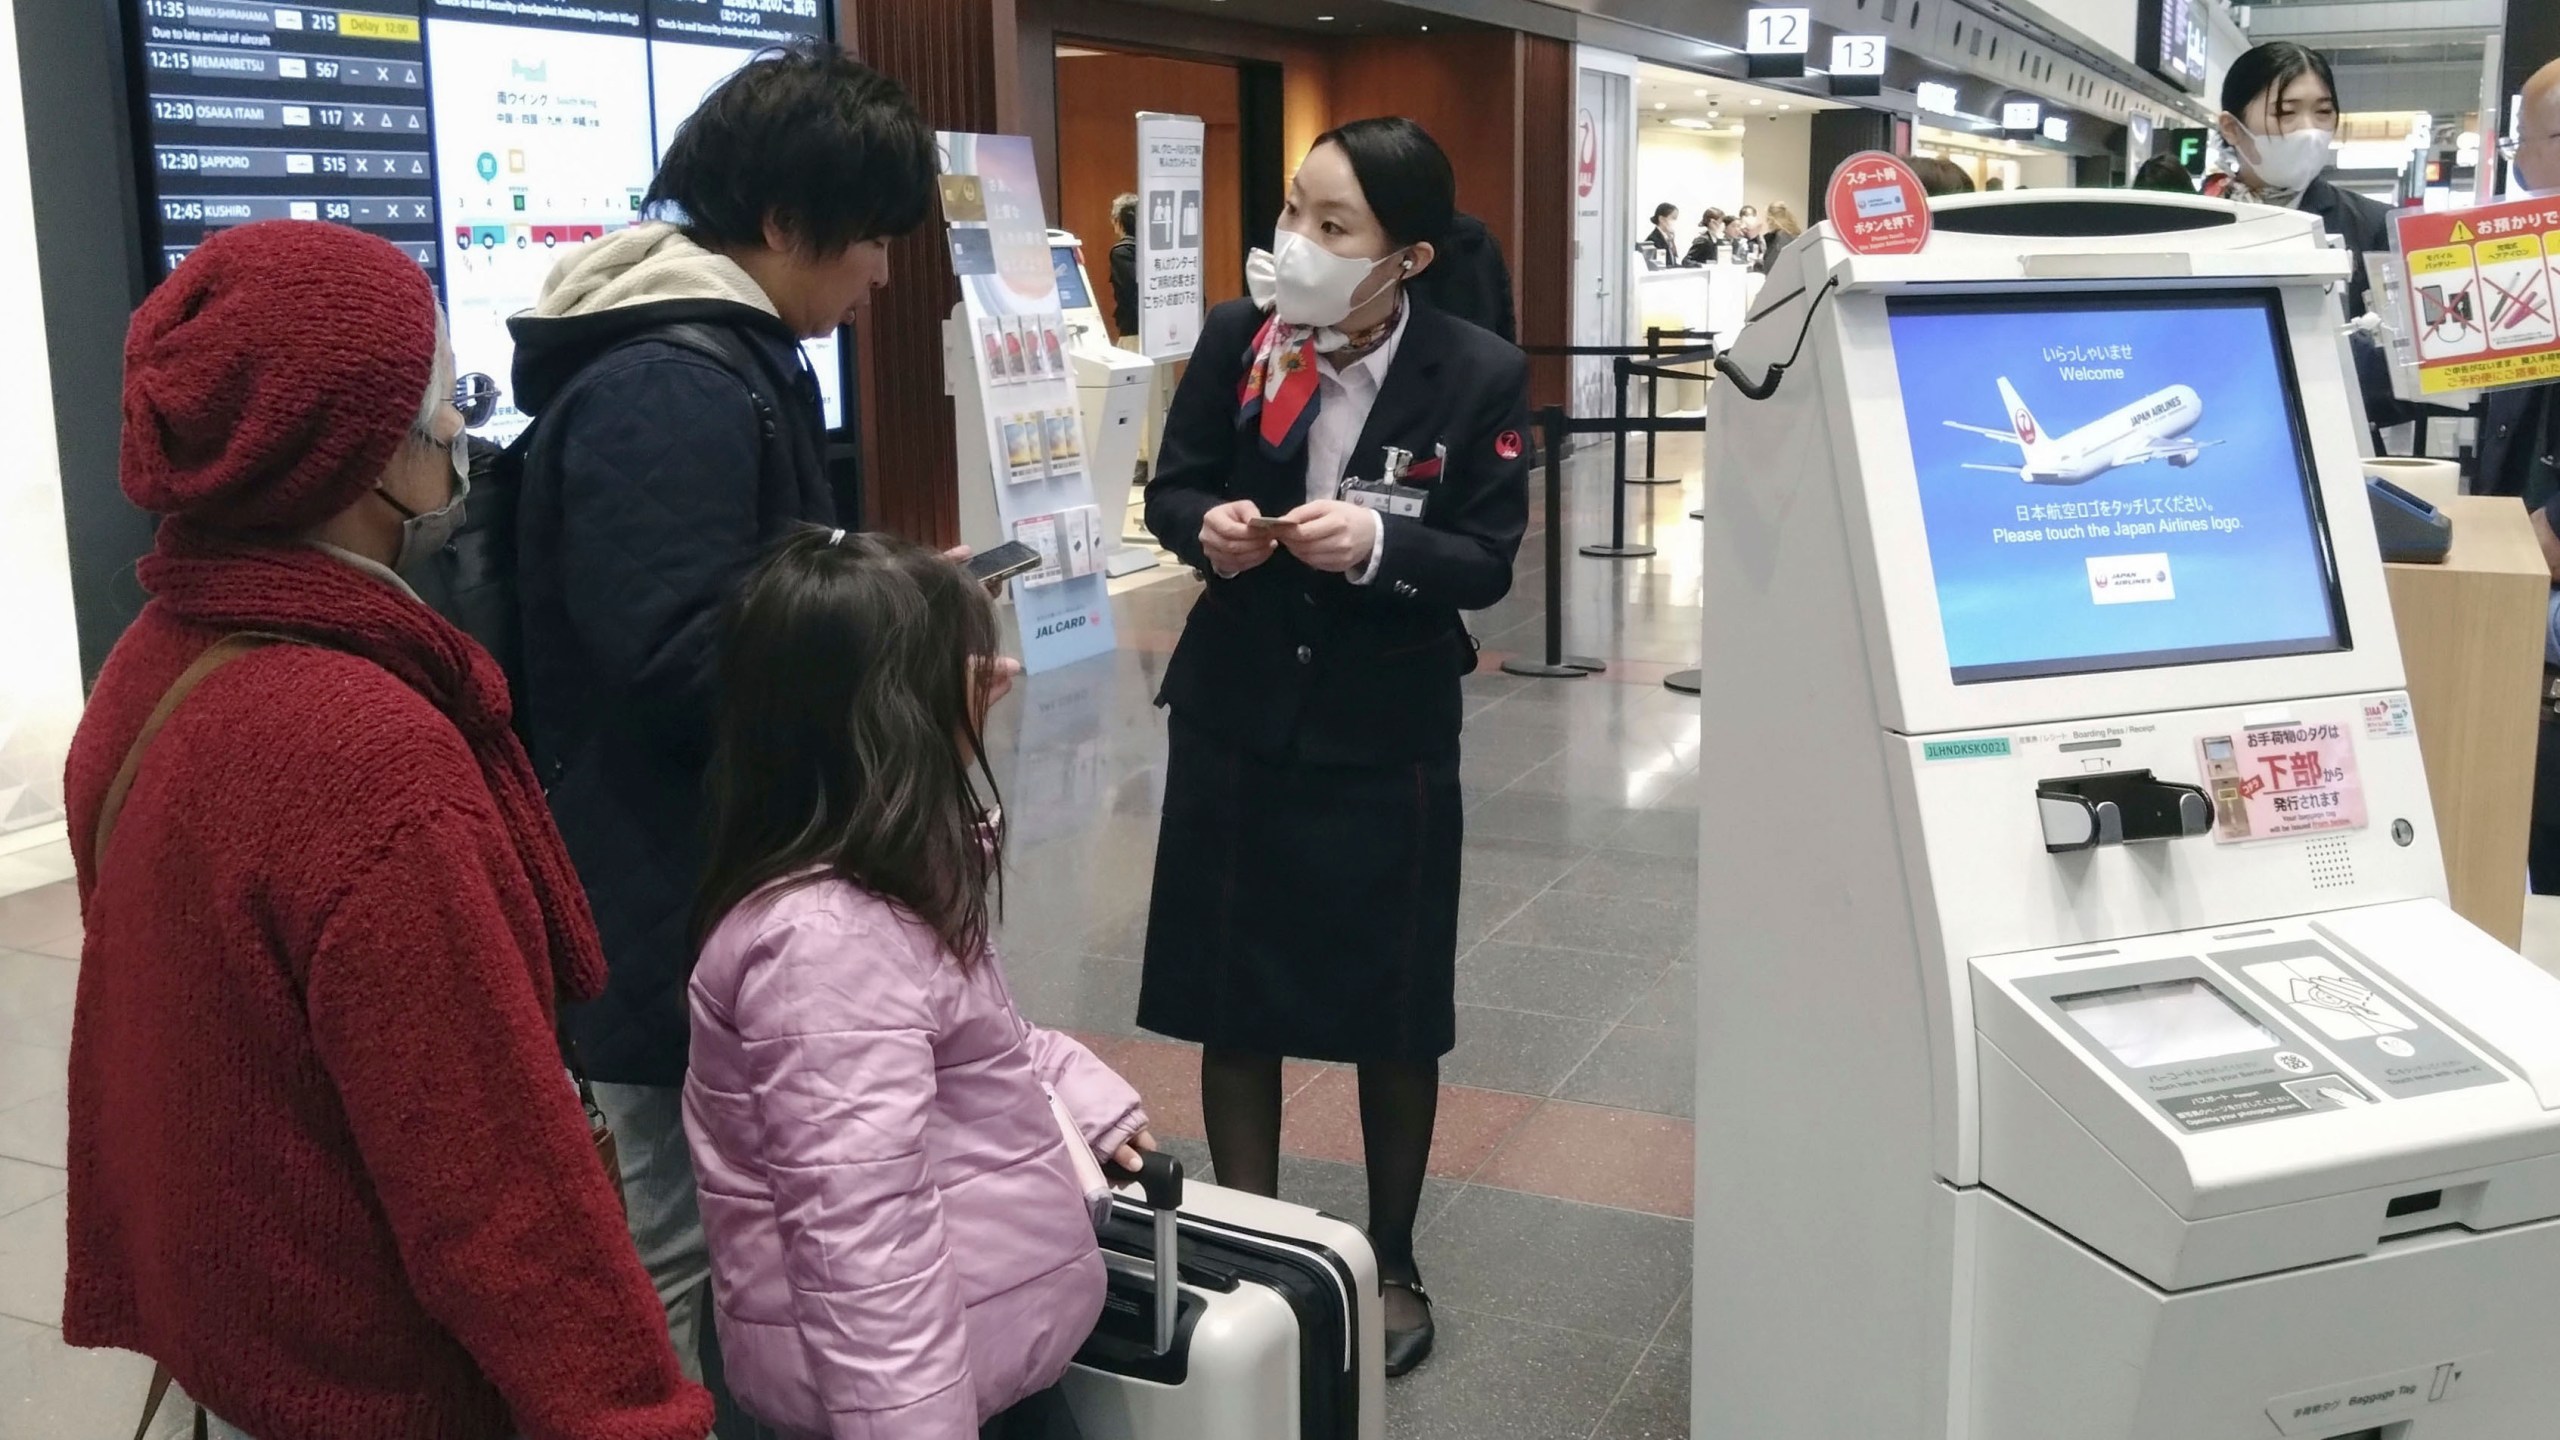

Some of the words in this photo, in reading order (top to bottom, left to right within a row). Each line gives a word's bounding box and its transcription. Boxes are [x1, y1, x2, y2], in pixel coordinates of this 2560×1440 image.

[146, 0, 185, 18] 11:35
[312, 14, 336, 31] 215
[351, 18, 379, 35] Delay
[152, 26, 172, 39] Due
[172, 28, 183, 40] to
[184, 28, 201, 41] late
[202, 30, 229, 43] arrival
[229, 32, 240, 44] of
[240, 33, 271, 46] aircraft
[1760, 15, 1798, 46] 12
[150, 51, 190, 69] 12:15
[191, 55, 265, 72] MEMANBETSU
[315, 62, 339, 78] 567
[1843, 41, 1875, 68] 13
[155, 102, 194, 120] 12:30
[195, 105, 234, 119] OSAKA
[234, 107, 265, 121] ITAMI
[320, 109, 343, 125] 117
[160, 153, 199, 170] 12:30
[200, 155, 250, 169] SAPPORO
[322, 156, 347, 172] 515
[2180, 137, 2199, 166] F
[1846, 166, 1898, 185] スタート時
[164, 203, 202, 220] 12:45
[204, 205, 251, 218] KUSHIRO
[326, 203, 350, 219] 543
[2476, 210, 2559, 235] お預かりで
[1853, 214, 1915, 236] ボタンを押下
[2042, 344, 2133, 363] いらっしゃいませ
[2059, 366, 2125, 382] Welcome
[2130, 410, 2152, 428] JAPAN
[2151, 396, 2182, 416] AIRLINES
[2015, 495, 2214, 521] 日本航空ロゴをタッチしてください。
[1992, 528, 2043, 543] Please
[2045, 524, 2086, 540] touch
[2087, 522, 2110, 538] the
[2113, 520, 2156, 540] Japan
[2159, 517, 2209, 533] Airlines
[2210, 515, 2245, 533] logo.
[2072, 728, 2106, 739] Boarding
[2106, 727, 2125, 736] Pass
[2129, 724, 2156, 733] Receipt
[2247, 724, 2340, 747] お手荷物のタグは
[2273, 791, 2341, 812] 発行されます
[2347, 1389, 2396, 1407] Baggage
[2398, 1384, 2418, 1396] Tag
